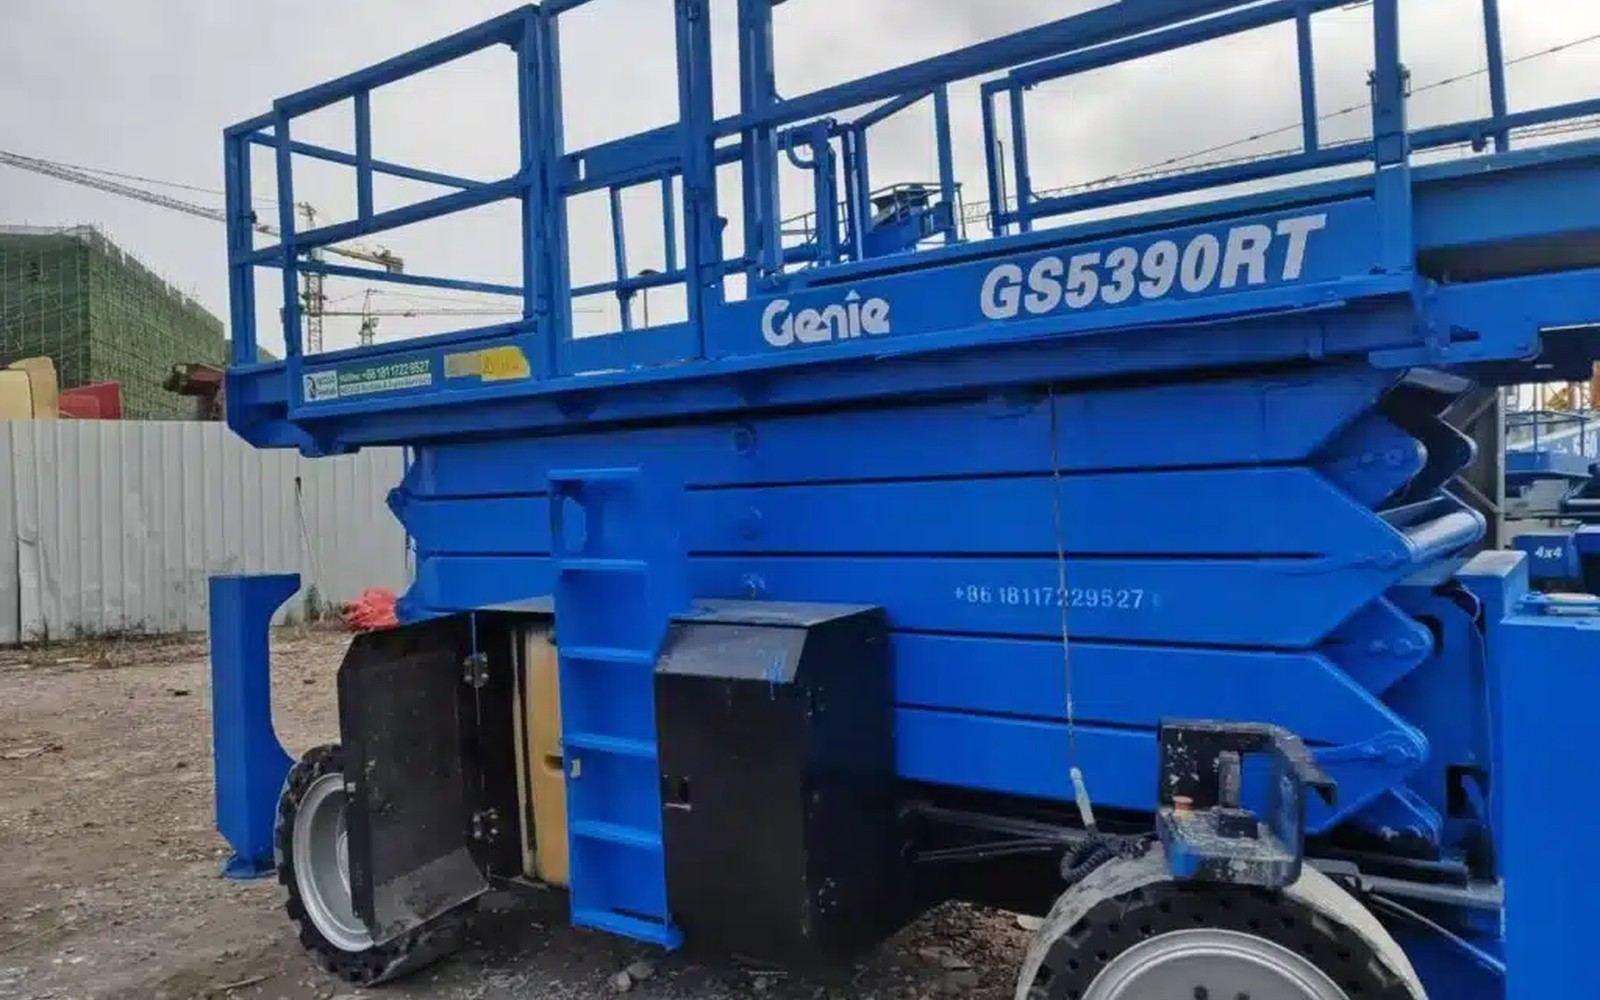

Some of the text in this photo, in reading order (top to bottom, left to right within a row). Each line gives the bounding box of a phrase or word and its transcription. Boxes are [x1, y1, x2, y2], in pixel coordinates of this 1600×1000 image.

[980, 213, 1327, 320] GS5390RT
[761, 289, 891, 347] Genie
[954, 585, 1145, 609] +86 18117229527
